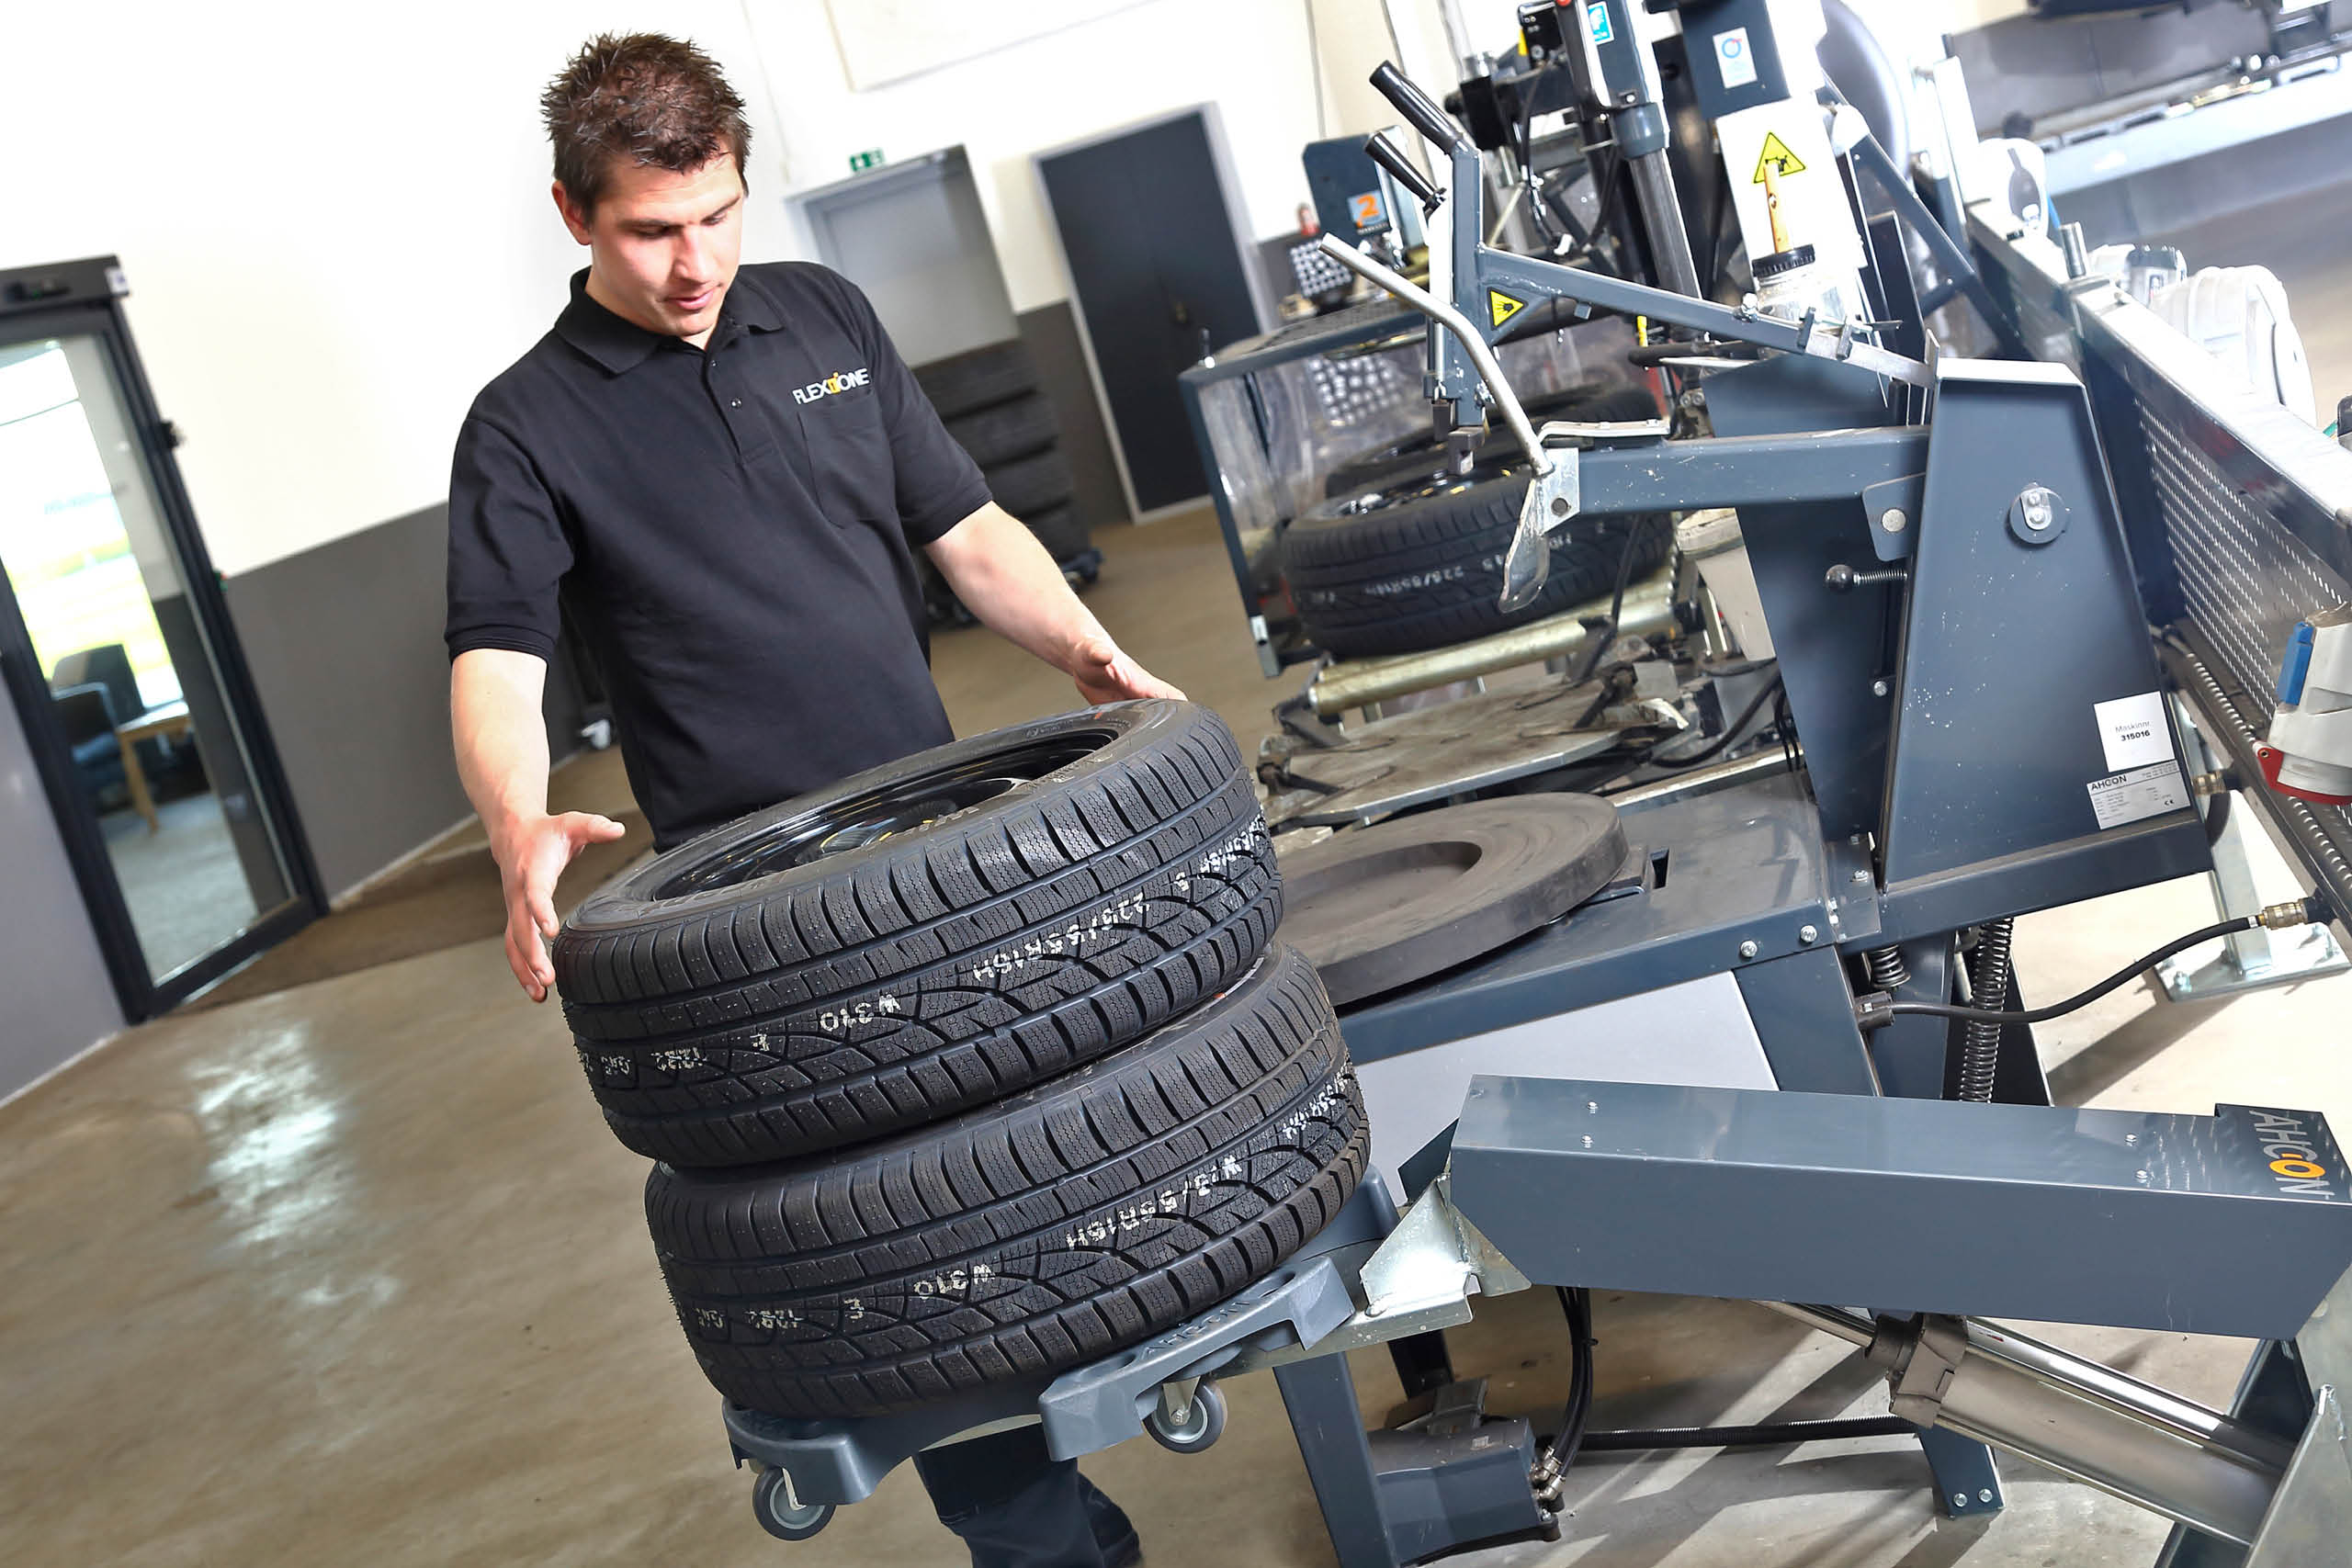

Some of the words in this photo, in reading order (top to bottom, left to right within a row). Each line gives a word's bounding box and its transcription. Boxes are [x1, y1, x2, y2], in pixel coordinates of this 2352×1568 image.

[1357, 195, 1380, 218] 2
[2120, 729, 2152, 741] 315016
[2091, 774, 2128, 791] AHCON
[972, 892, 1151, 982] 225/55R16H
